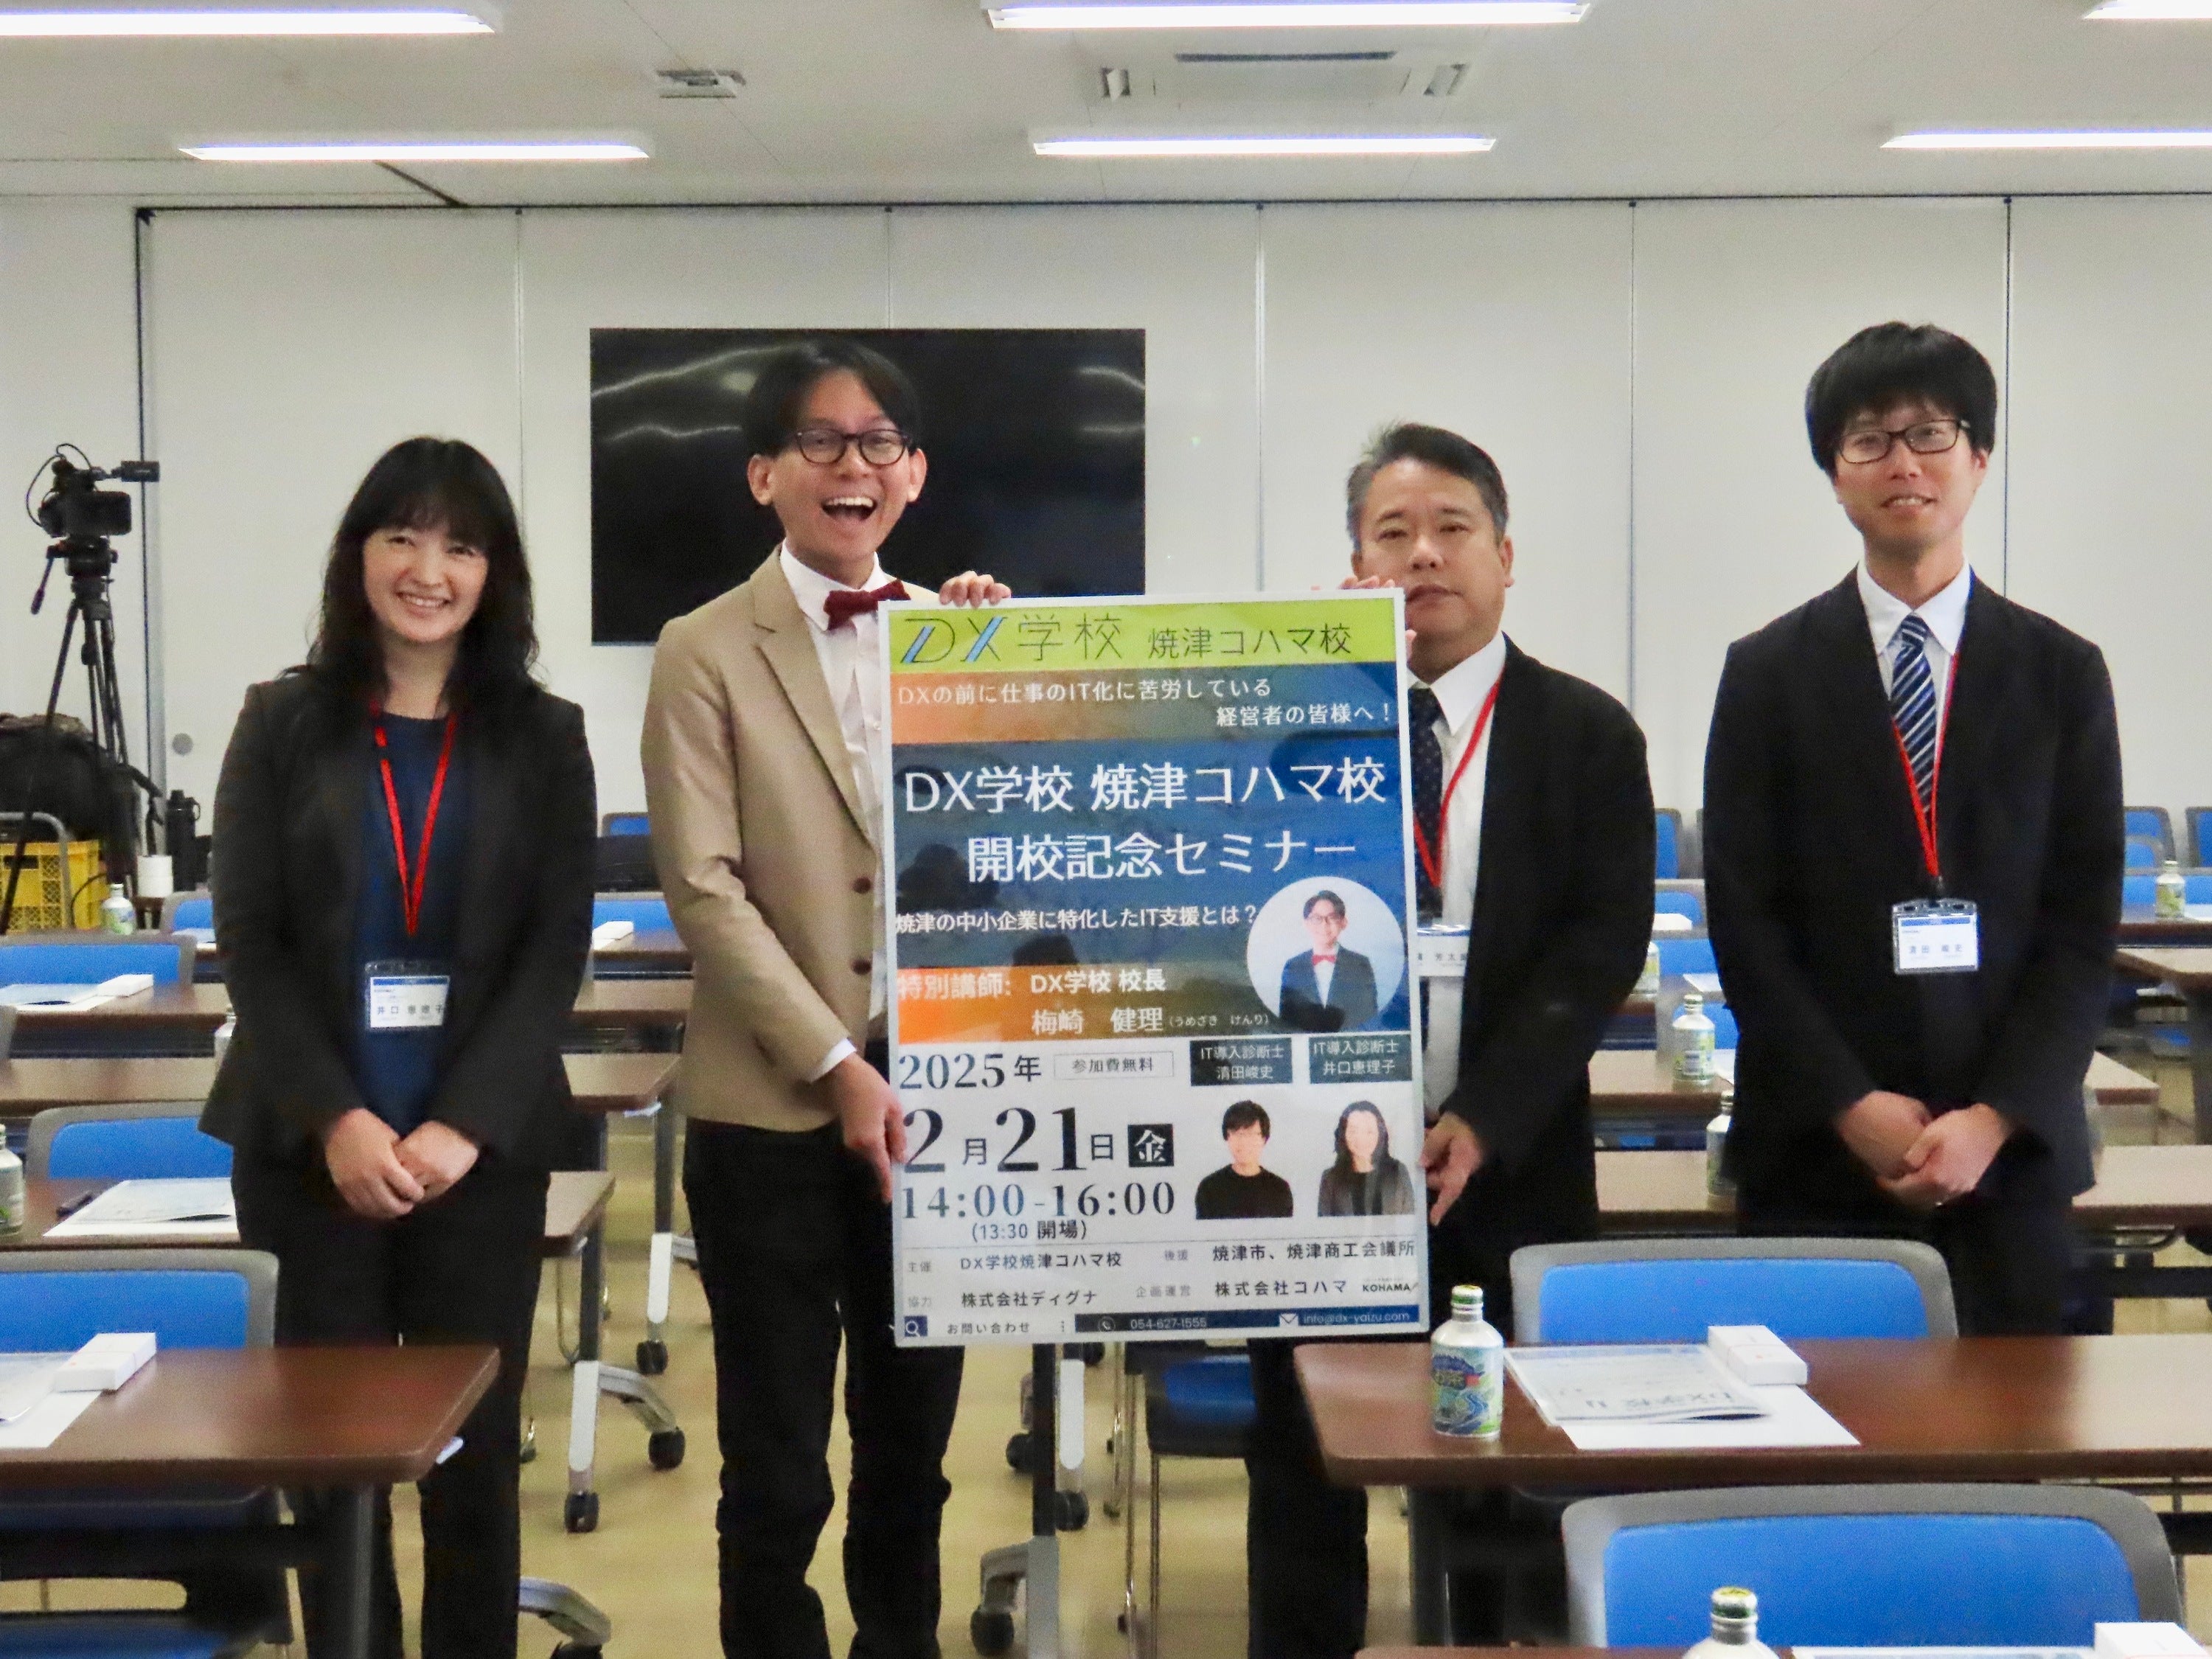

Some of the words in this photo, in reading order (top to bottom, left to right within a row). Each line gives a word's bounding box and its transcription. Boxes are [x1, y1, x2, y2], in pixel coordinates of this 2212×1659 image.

[902, 613, 1122, 664] DX学校
[1148, 622, 1352, 659] 焼津コハマ校
[898, 678, 1272, 706] DXの前に仕事のIT化に苦労している
[905, 765, 1074, 813] DX学校
[1091, 756, 1387, 811] 焼津コハマ校
[968, 830, 1356, 883] 開校記念セミナー
[896, 906, 1257, 934] 焼津の中小企業に特化したIT支援とは？
[1031, 970, 1111, 994] DX学校
[1119, 968, 1166, 992] 校長
[1110, 1006, 1164, 1033] 健理
[1200, 1044, 1284, 1060] IT導入診断士
[1313, 1038, 1399, 1056] IT導入診断士
[898, 1052, 1042, 1090] 2025年
[1072, 1056, 1154, 1074] 参加費無料
[1133, 1127, 1169, 1164] 金
[908, 1261, 932, 1273] 主催
[960, 1251, 1122, 1270] DX学校焼津コハマ校
[1212, 1240, 1416, 1262] 焼津市、焼津商工会議所
[961, 1290, 1097, 1308] 株式会社ディグナ
[1214, 1280, 1347, 1298] 株式会社コハマ
[1362, 1283, 1411, 1293] KOHAMA
[947, 1321, 1030, 1335] お問い合わせ
[1130, 1317, 1207, 1329] 054-627-1555
